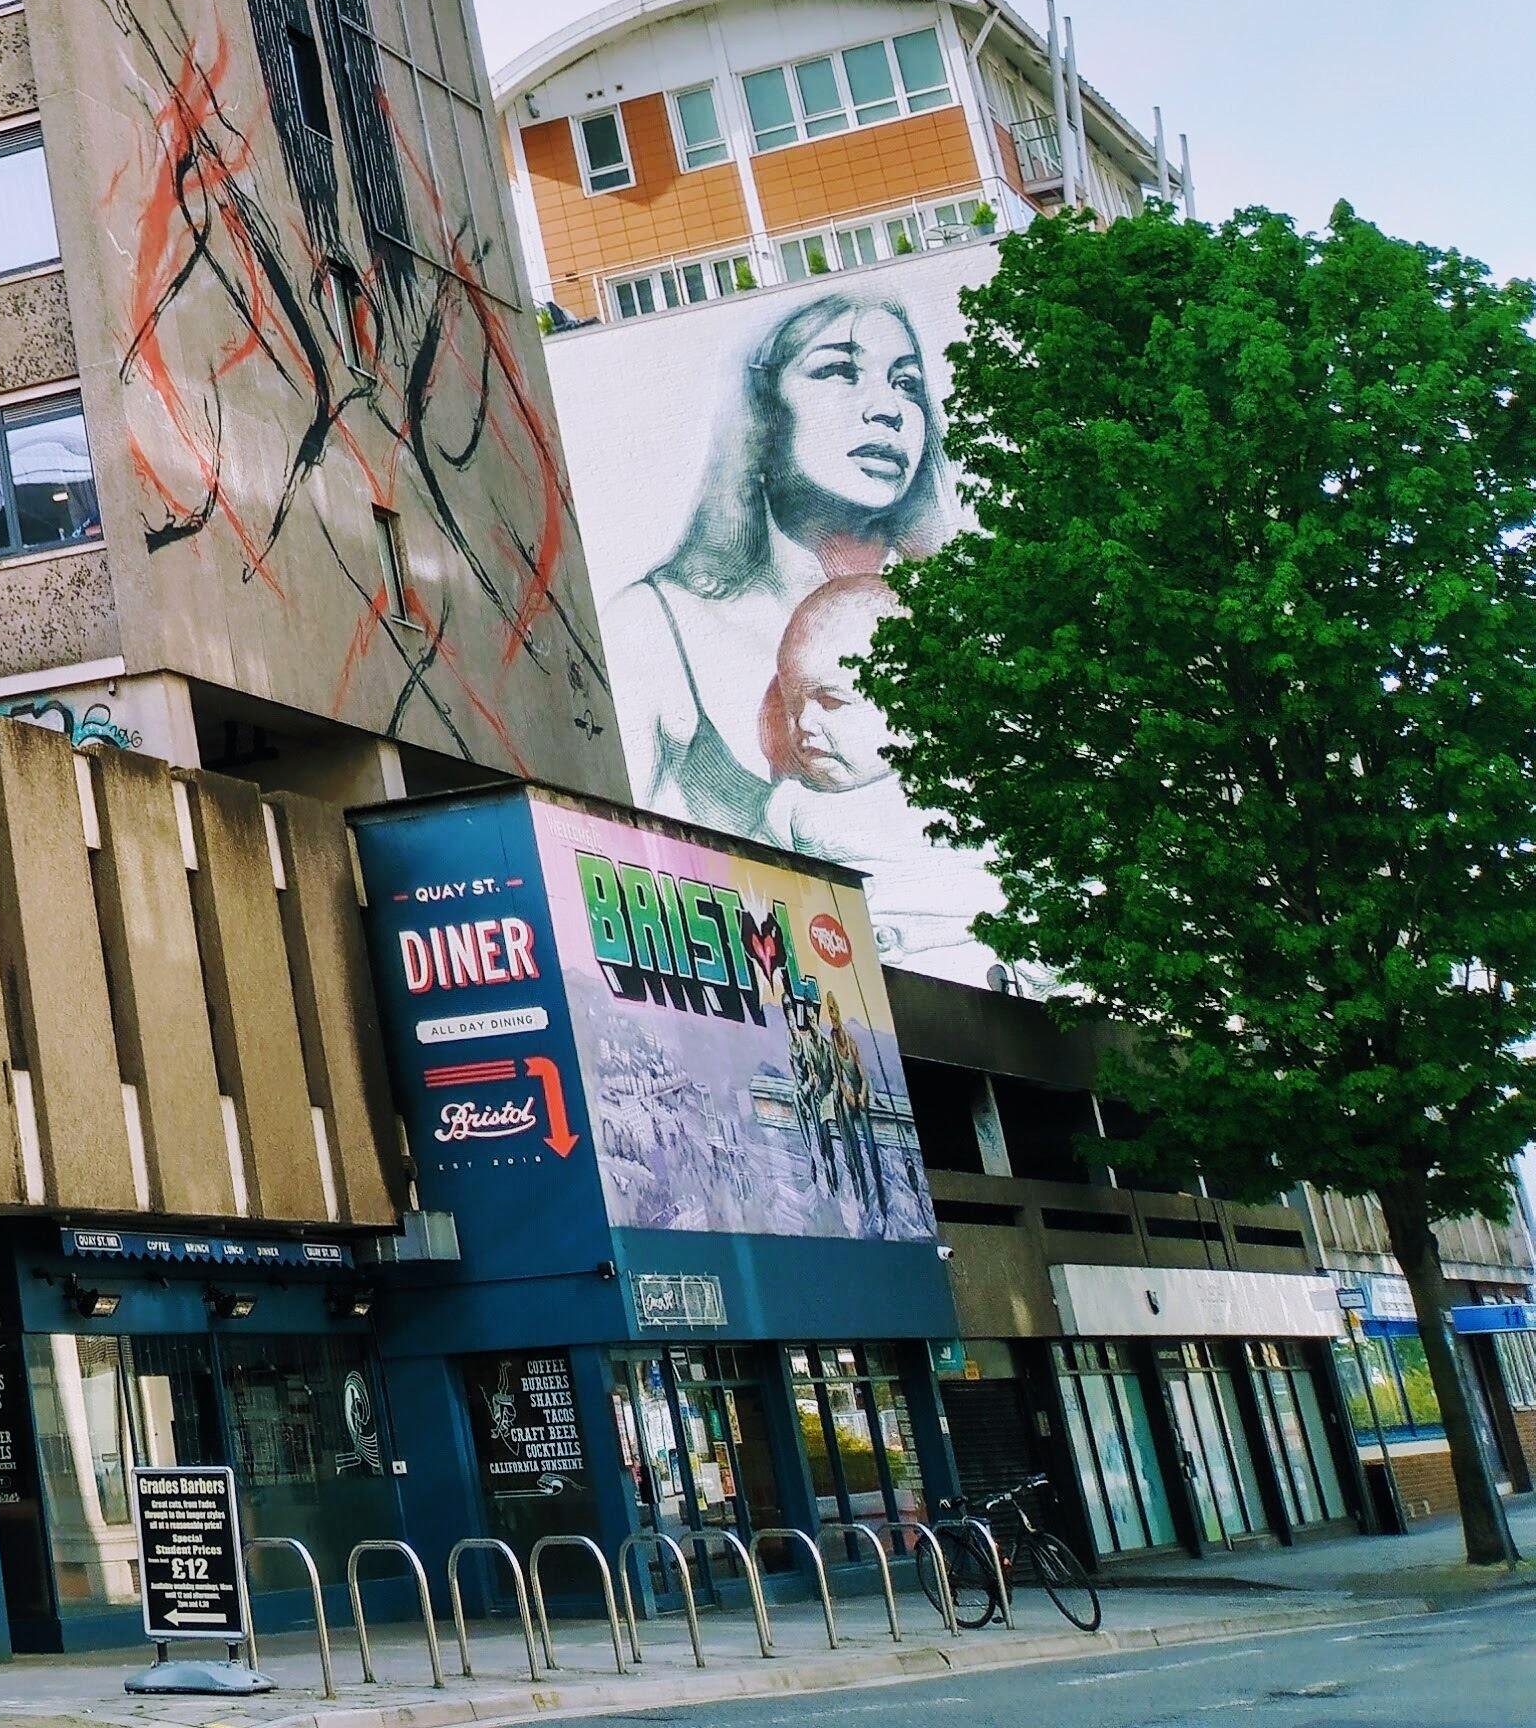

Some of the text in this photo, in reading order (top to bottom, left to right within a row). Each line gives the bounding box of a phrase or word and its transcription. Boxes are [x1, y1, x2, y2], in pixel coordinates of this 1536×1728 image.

[415, 878, 501, 903] QUAY ST.
[399, 917, 540, 994] DINER
[431, 1015, 534, 1036] ALL DAY DINING
[434, 1096, 536, 1142] Bristol
[147, 1240, 171, 1252] COFFEE
[223, 1244, 245, 1255] LUNCH
[527, 1359, 567, 1375] COFFEE
[520, 1375, 570, 1392] BURGERS
[530, 1391, 573, 1408] SHAKES
[543, 1408, 576, 1424] TACOS
[510, 1424, 579, 1442] CRAFT BEER
[525, 1442, 582, 1459] COCKTAILS
[489, 1458, 585, 1474] CALIFORNIA SUNSHINE
[139, 1477, 225, 1494] Grades Barbers
[151, 1500, 168, 1509] Great
[175, 1511, 185, 1519] the
[172, 1533, 203, 1544] Special
[155, 1544, 222, 1555] Student Prices
[171, 1557, 209, 1580] £12
